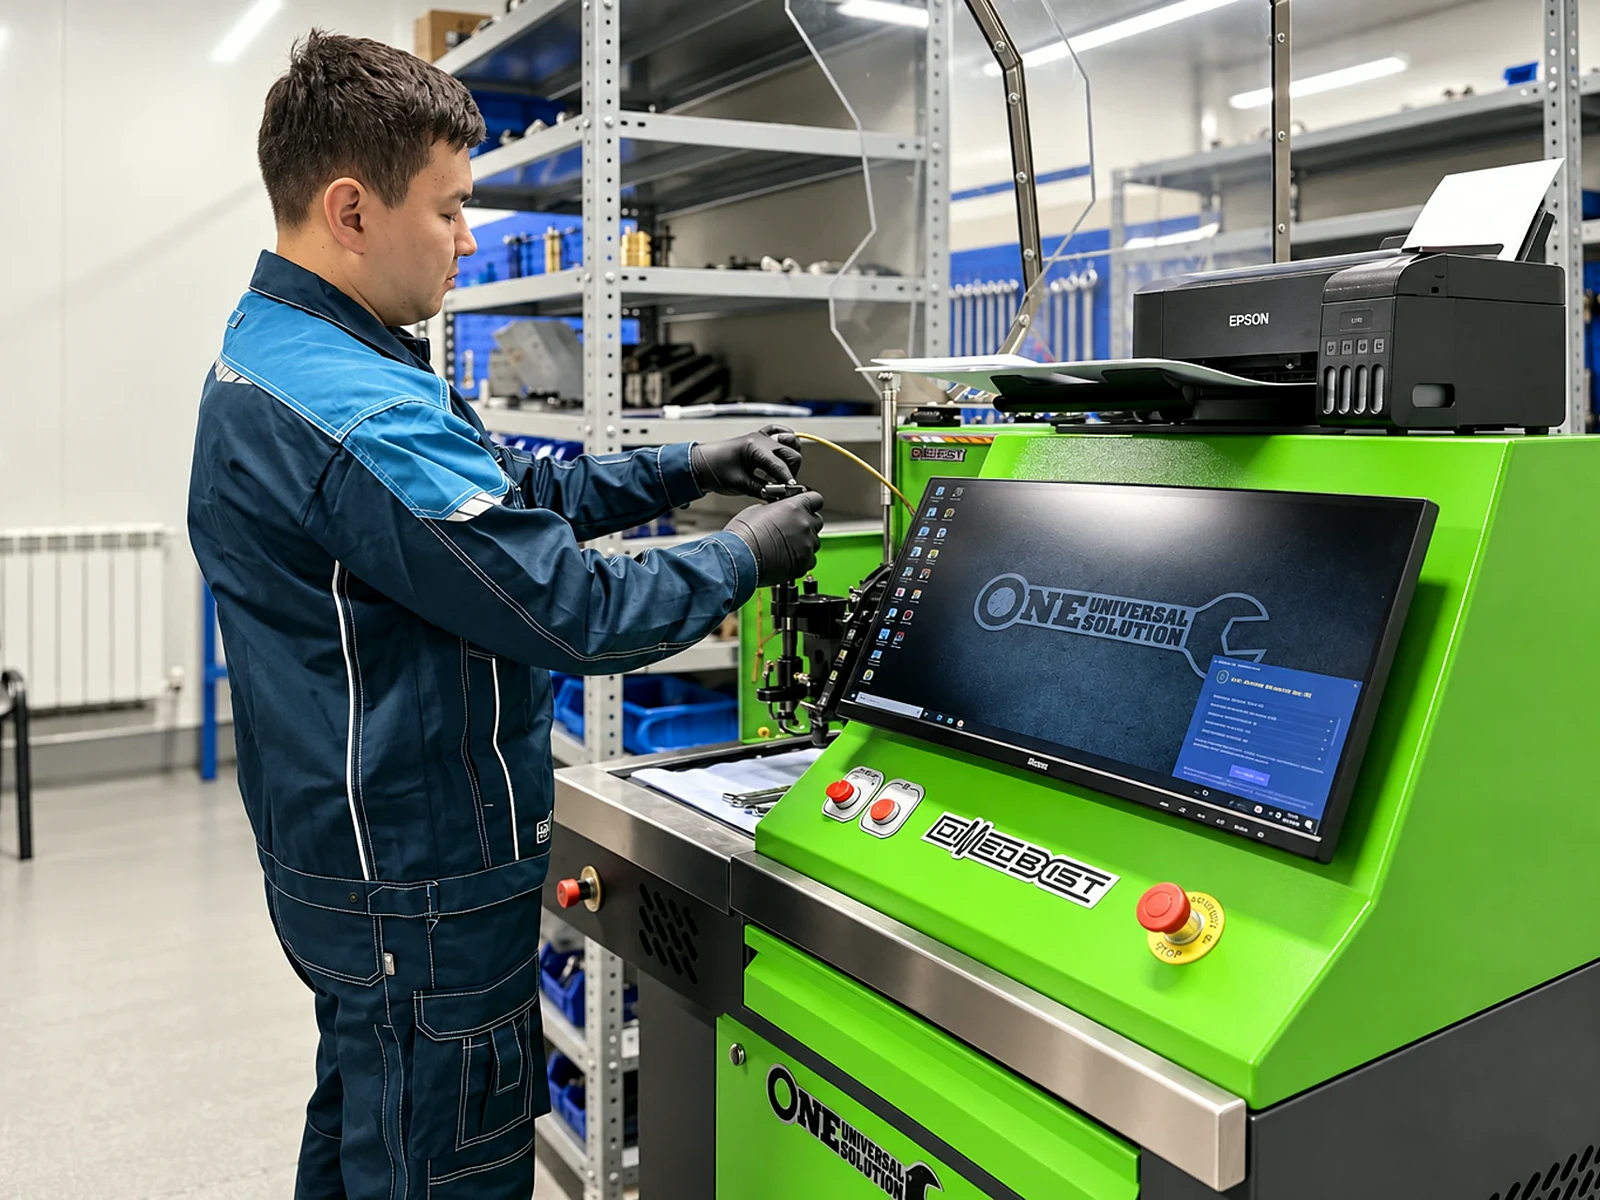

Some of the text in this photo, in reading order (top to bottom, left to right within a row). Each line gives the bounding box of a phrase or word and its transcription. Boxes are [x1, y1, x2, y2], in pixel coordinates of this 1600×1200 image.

[1229, 312, 1270, 327] EPSON
[975, 574, 1189, 630] ONE UNIVERSAL
[1081, 614, 1184, 647] SOLUTION
[767, 1066, 905, 1183] ONE UNIVERSAL
[840, 1140, 904, 1200] SOLUTION
